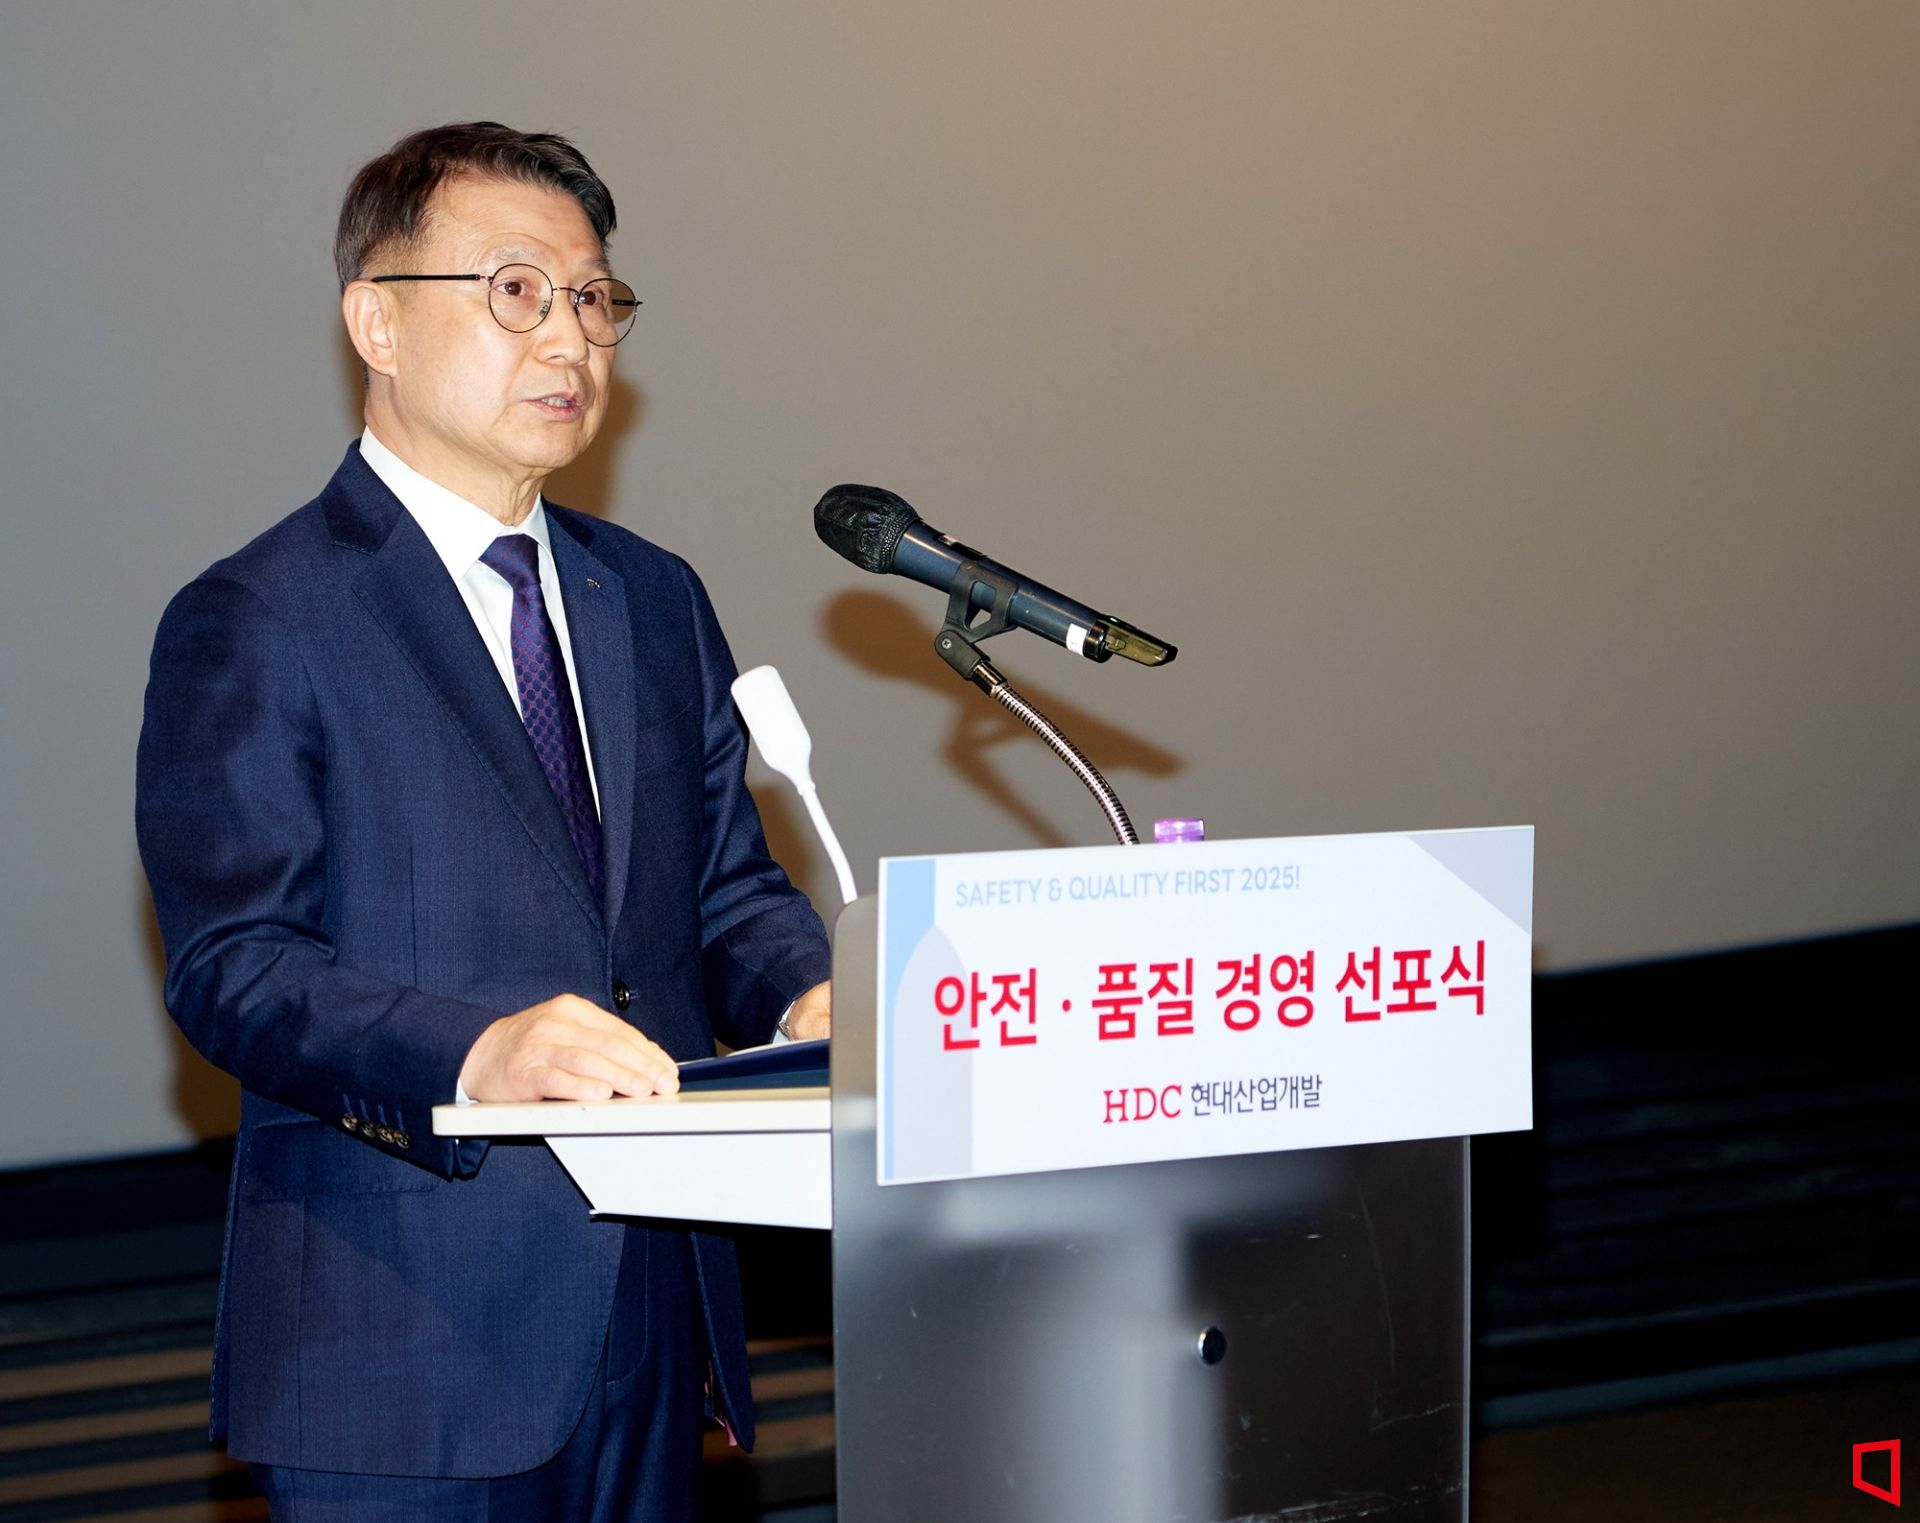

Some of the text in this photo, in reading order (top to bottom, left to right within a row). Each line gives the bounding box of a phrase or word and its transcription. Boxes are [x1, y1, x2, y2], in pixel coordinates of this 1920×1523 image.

[956, 864, 1300, 907] SAFETY & QUALITY FIRST 2025!
[933, 967, 1038, 1052] 안전
[1091, 957, 1195, 1041] 품질
[1215, 950, 1315, 1032] 경영
[1335, 939, 1485, 1023] 선포식
[1103, 1074, 1323, 1124] HDC 현대산업개발
